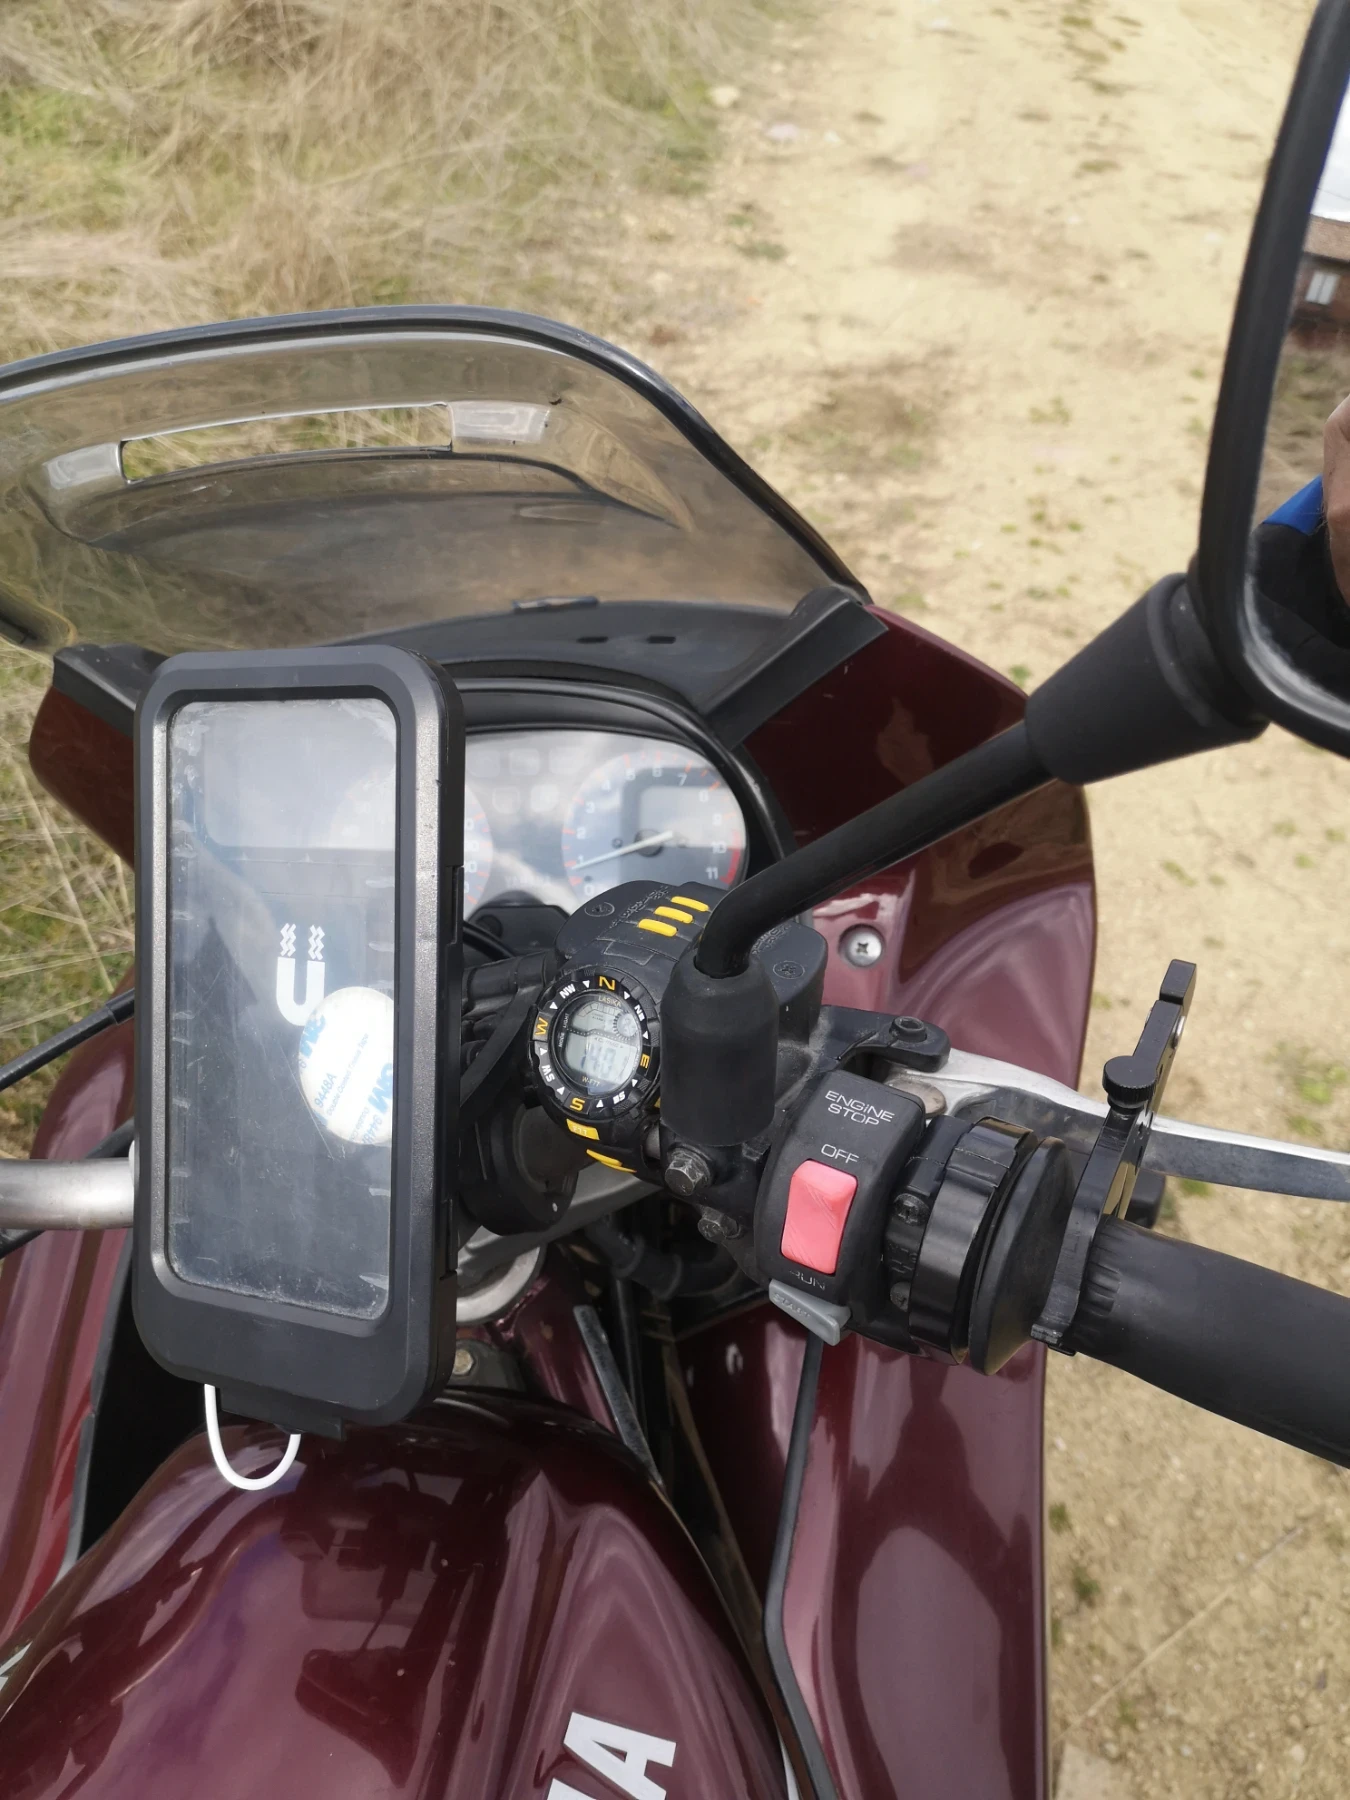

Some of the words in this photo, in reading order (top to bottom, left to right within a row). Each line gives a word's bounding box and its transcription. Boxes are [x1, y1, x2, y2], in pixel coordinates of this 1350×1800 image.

[625, 769, 636, 781] 5
[677, 773, 687, 786] 7
[586, 802, 596, 813] 3
[576, 827, 587, 839] 2
[706, 867, 719, 880] 11
[584, 885, 594, 897] 0
[599, 975, 616, 991] N
[559, 983, 576, 999] NW
[535, 1017, 549, 1036] W
[640, 1053, 650, 1068] E
[542, 1065, 555, 1082] SW
[314, 1073, 336, 1108] 9448A
[570, 1097, 586, 1112] S
[825, 1090, 895, 1123] ENGINE
[828, 1103, 880, 1127] STOP
[820, 1143, 860, 1164] OFF
